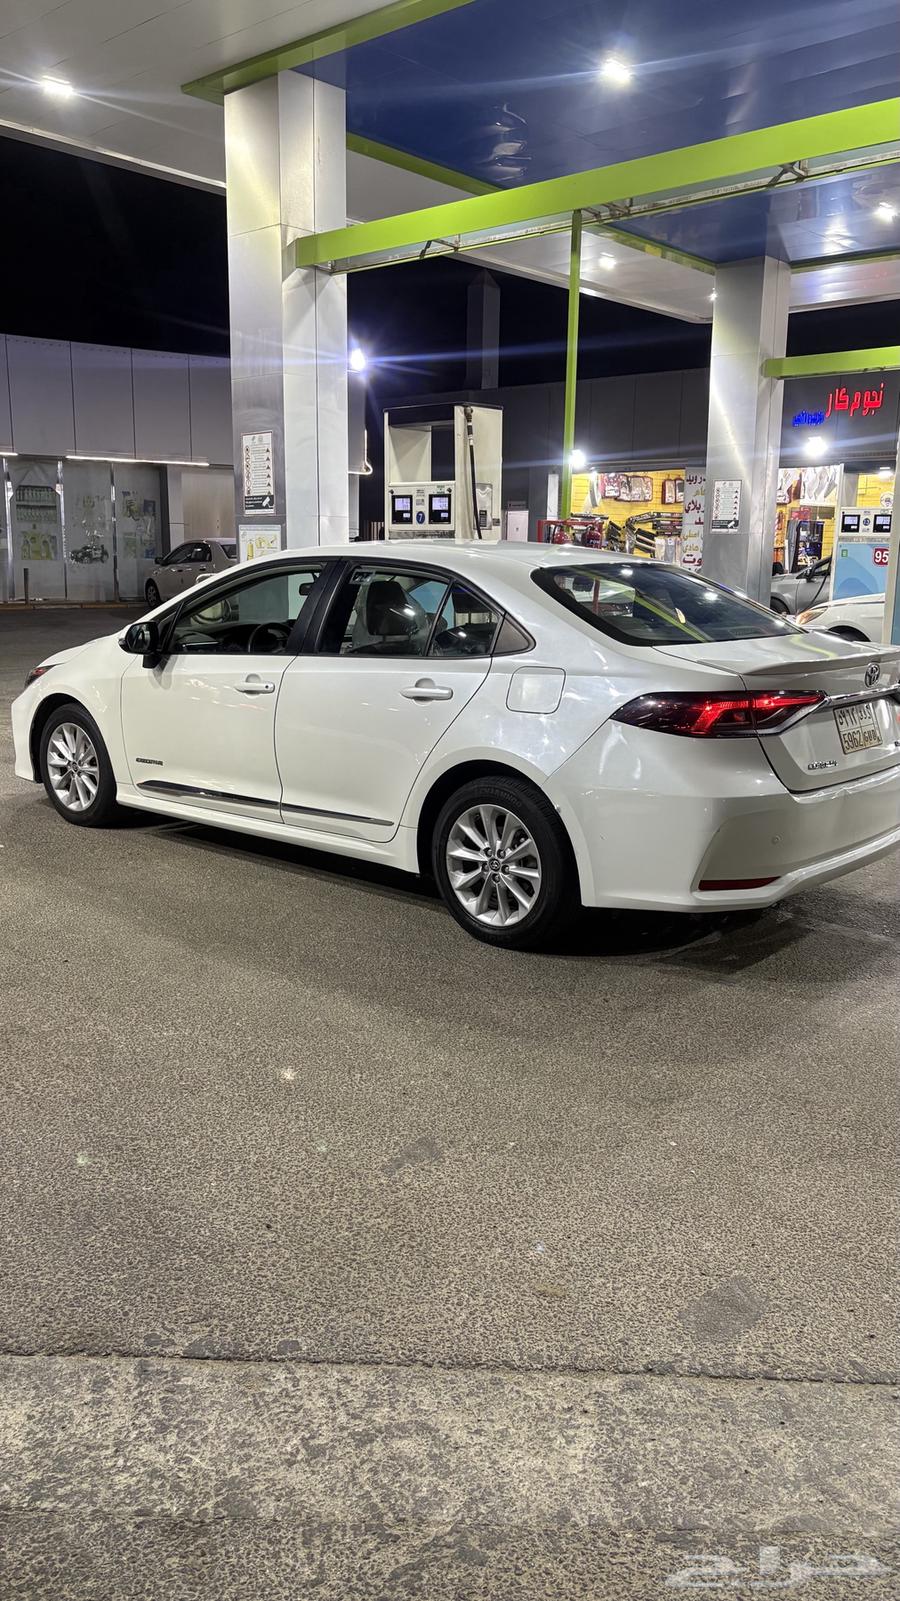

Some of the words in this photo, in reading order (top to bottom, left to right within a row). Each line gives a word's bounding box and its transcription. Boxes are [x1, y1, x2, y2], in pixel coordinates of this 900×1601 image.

[825, 387, 849, 418] كار
[849, 382, 884, 417] نجوم
[875, 550, 889, 563] 95
[843, 730, 864, 750] 5962
